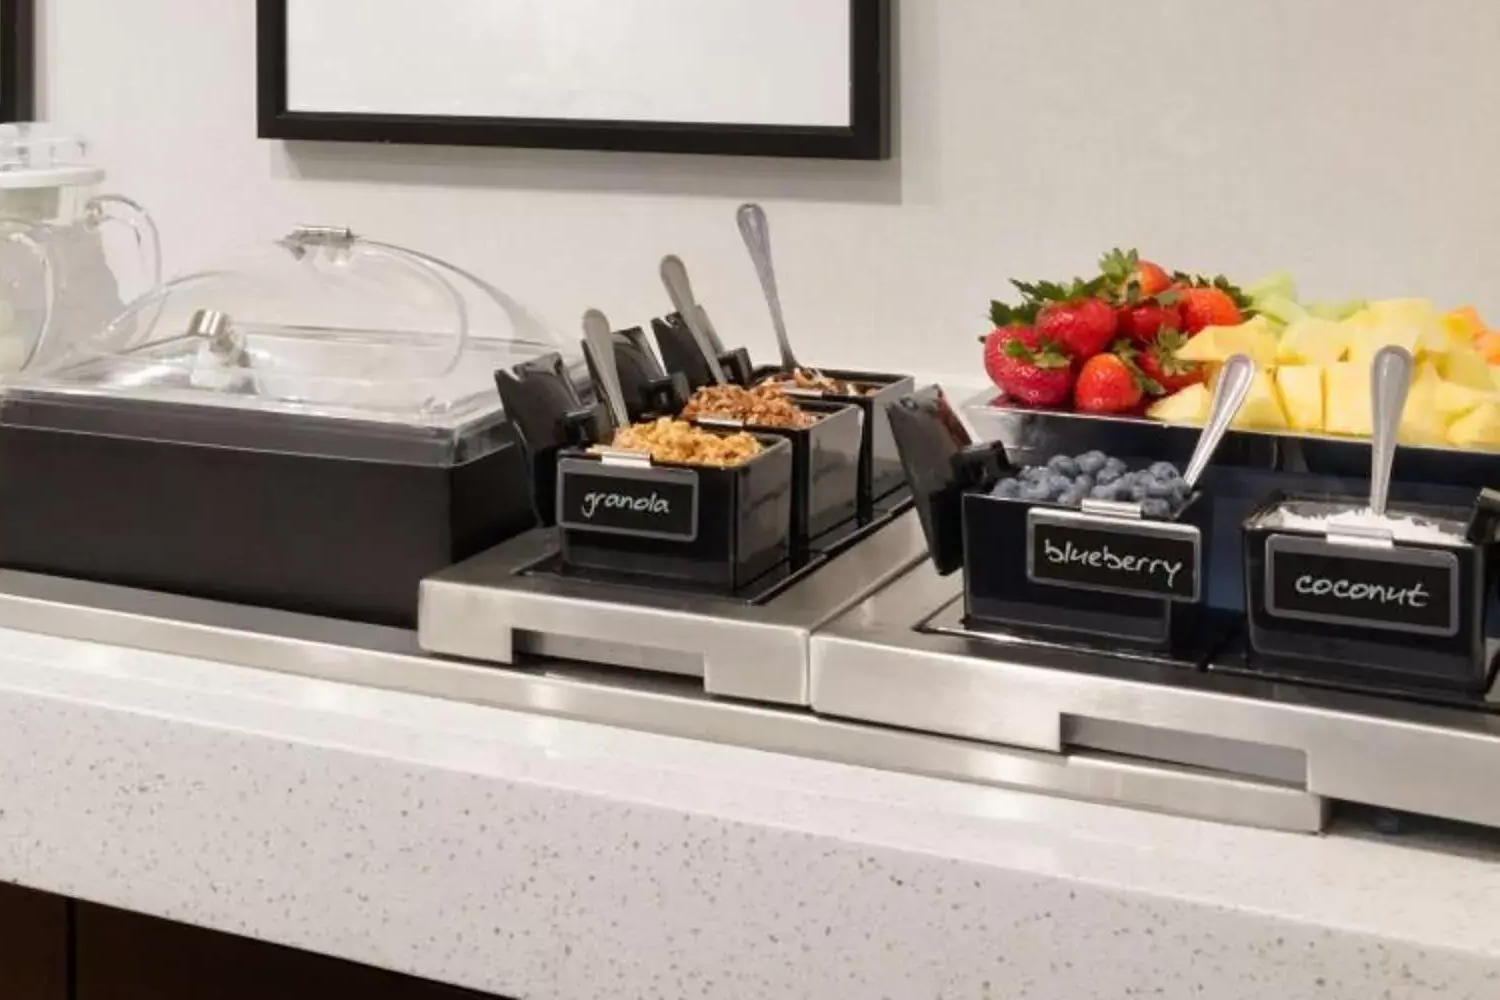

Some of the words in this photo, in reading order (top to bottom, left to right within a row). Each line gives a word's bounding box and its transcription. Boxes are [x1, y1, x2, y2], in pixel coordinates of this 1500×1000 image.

[580, 490, 671, 518] granola
[1044, 538, 1183, 588] blueberry
[1294, 573, 1432, 608] coconut
